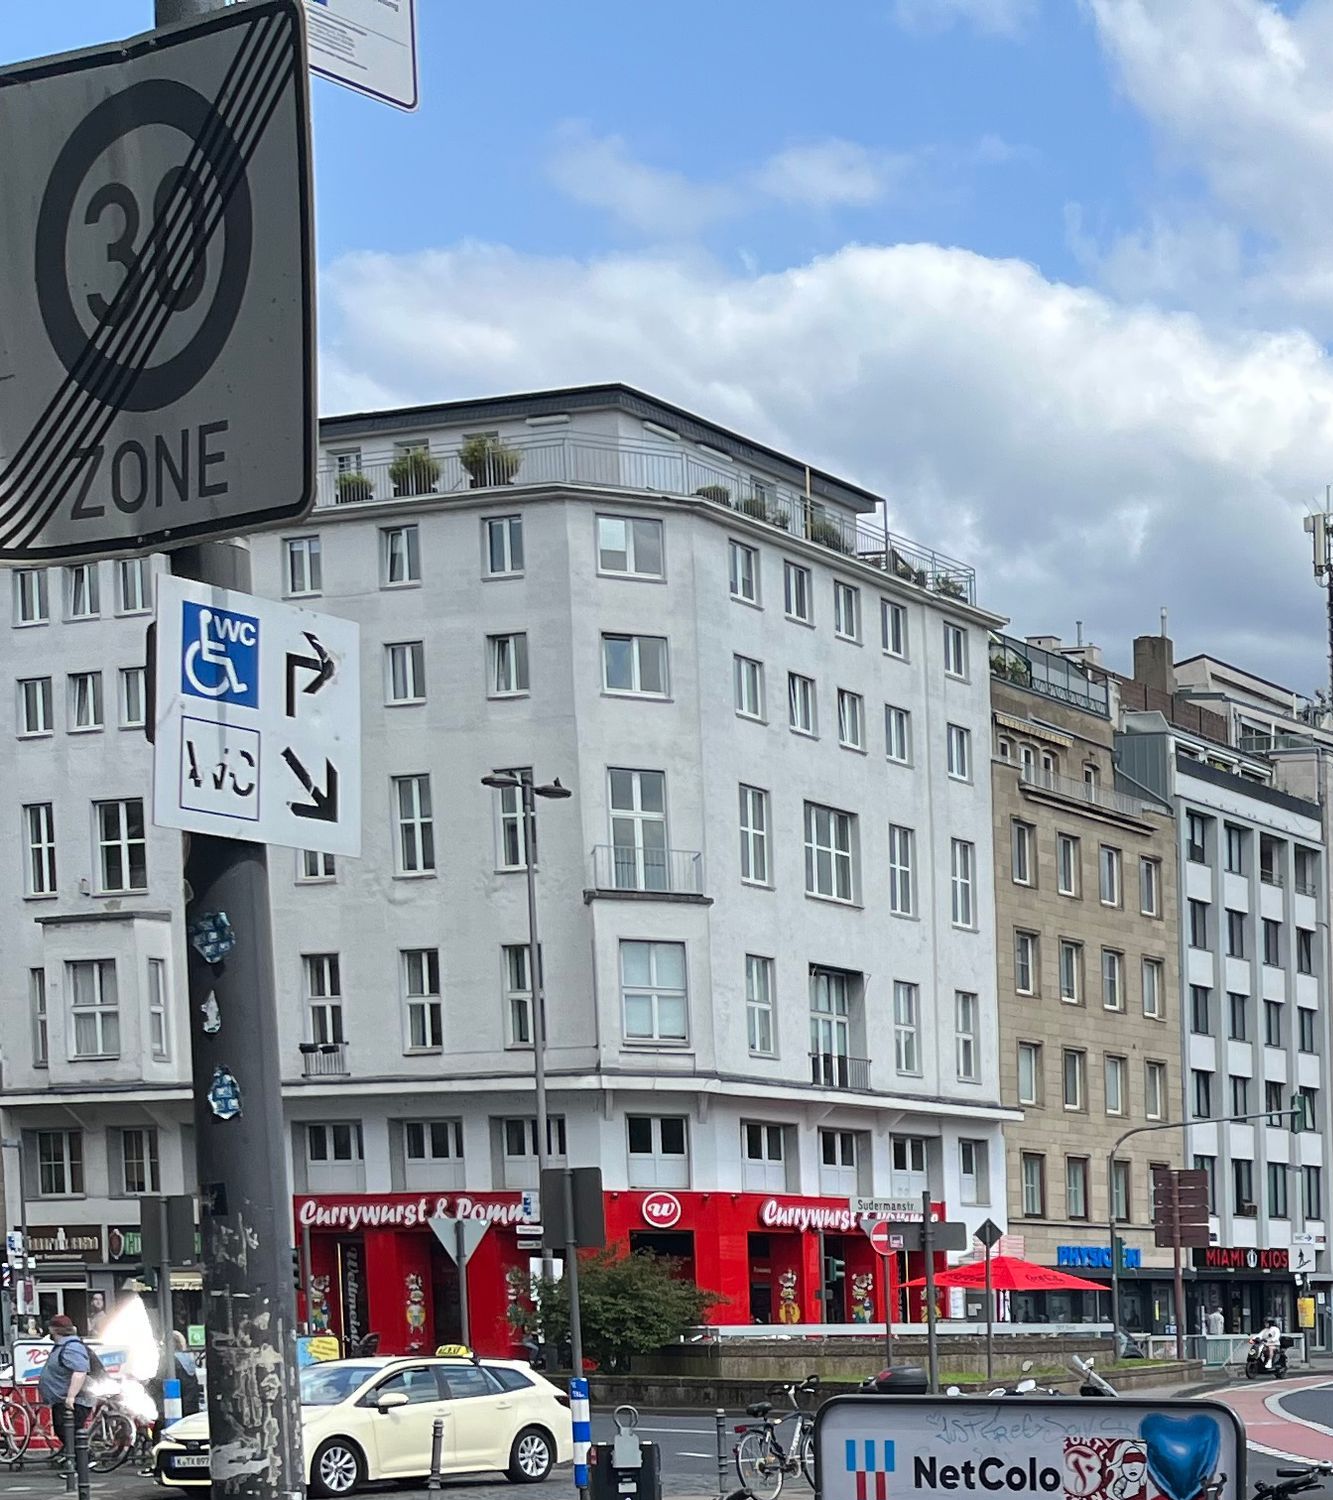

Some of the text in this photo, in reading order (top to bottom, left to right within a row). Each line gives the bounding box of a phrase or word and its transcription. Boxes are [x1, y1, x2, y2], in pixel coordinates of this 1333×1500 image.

[84, 165, 207, 327] 30
[70, 419, 229, 520] ZONE
[213, 615, 256, 646] WC
[300, 1199, 427, 1231] Currywurst
[455, 1197, 528, 1226] Pomm
[762, 1199, 858, 1231] Currywurst
[1206, 1248, 1288, 1269] MIAMI KIOS
[914, 1456, 1060, 1491] NetColo
